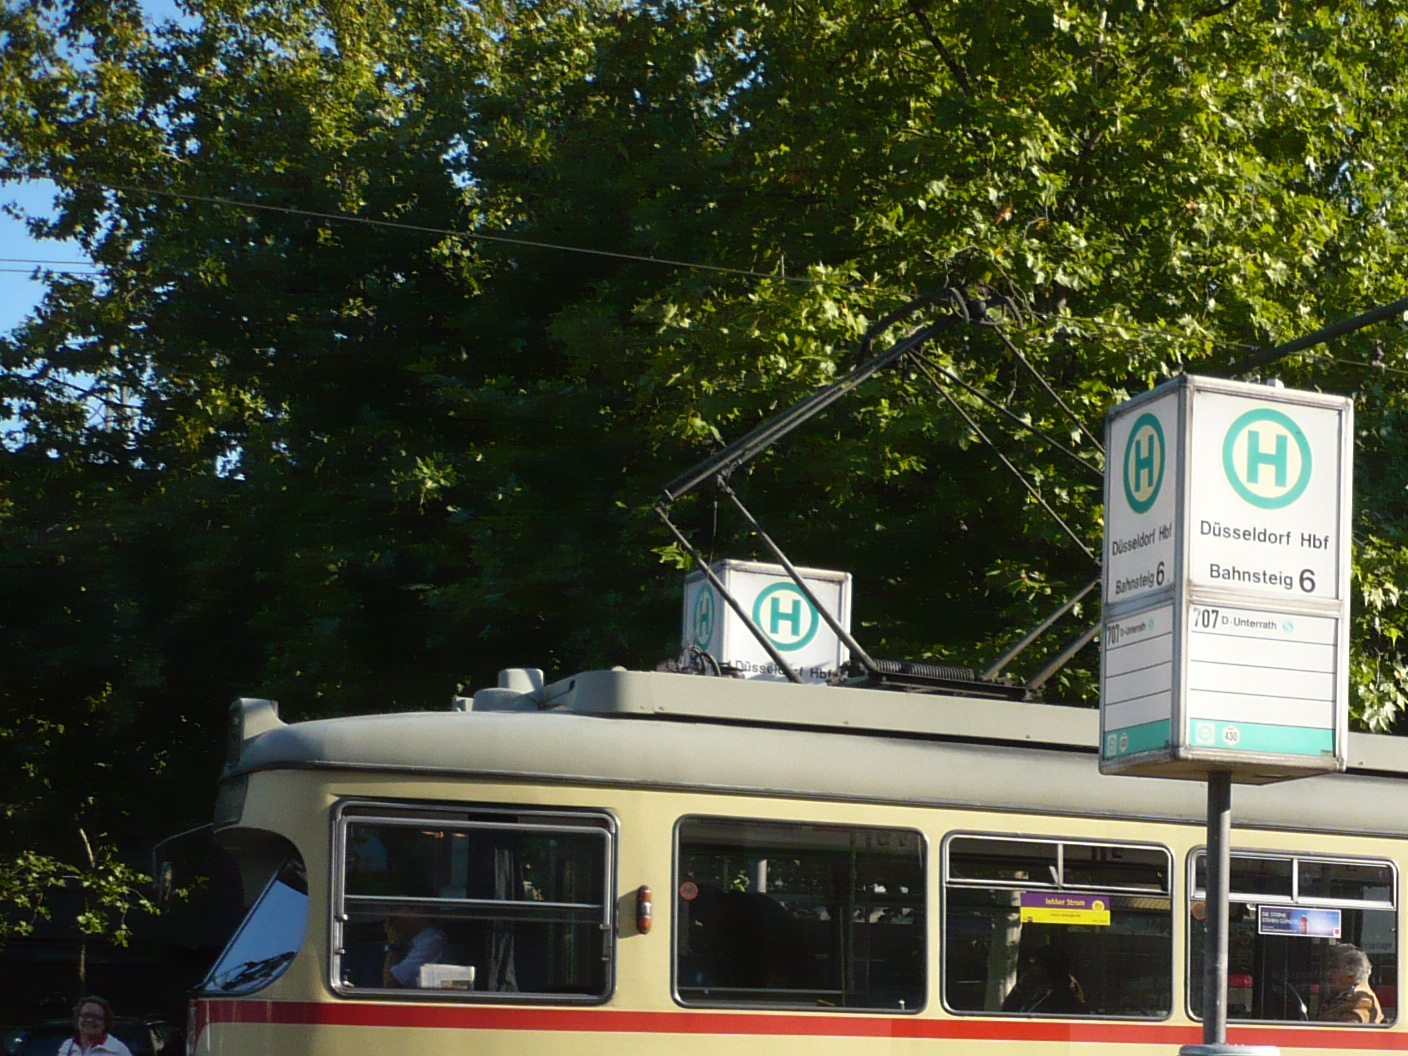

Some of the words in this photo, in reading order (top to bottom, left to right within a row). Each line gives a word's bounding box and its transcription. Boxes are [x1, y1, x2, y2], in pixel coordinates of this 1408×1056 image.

[1135, 434, 1155, 493] H
[1246, 430, 1288, 488] H
[1111, 527, 1156, 556] Düsseldorf
[1158, 522, 1173, 542] Hbf
[1199, 520, 1292, 546] Düsseldorf
[1299, 532, 1330, 550] Hbf
[1115, 570, 1155, 595] Bahnsteig
[1156, 561, 1166, 586] 6
[1209, 563, 1294, 590] Bahnsteig
[1299, 568, 1316, 593] 6
[769, 597, 801, 637] H
[1192, 608, 1220, 629] 707
[1106, 623, 1120, 646] 707
